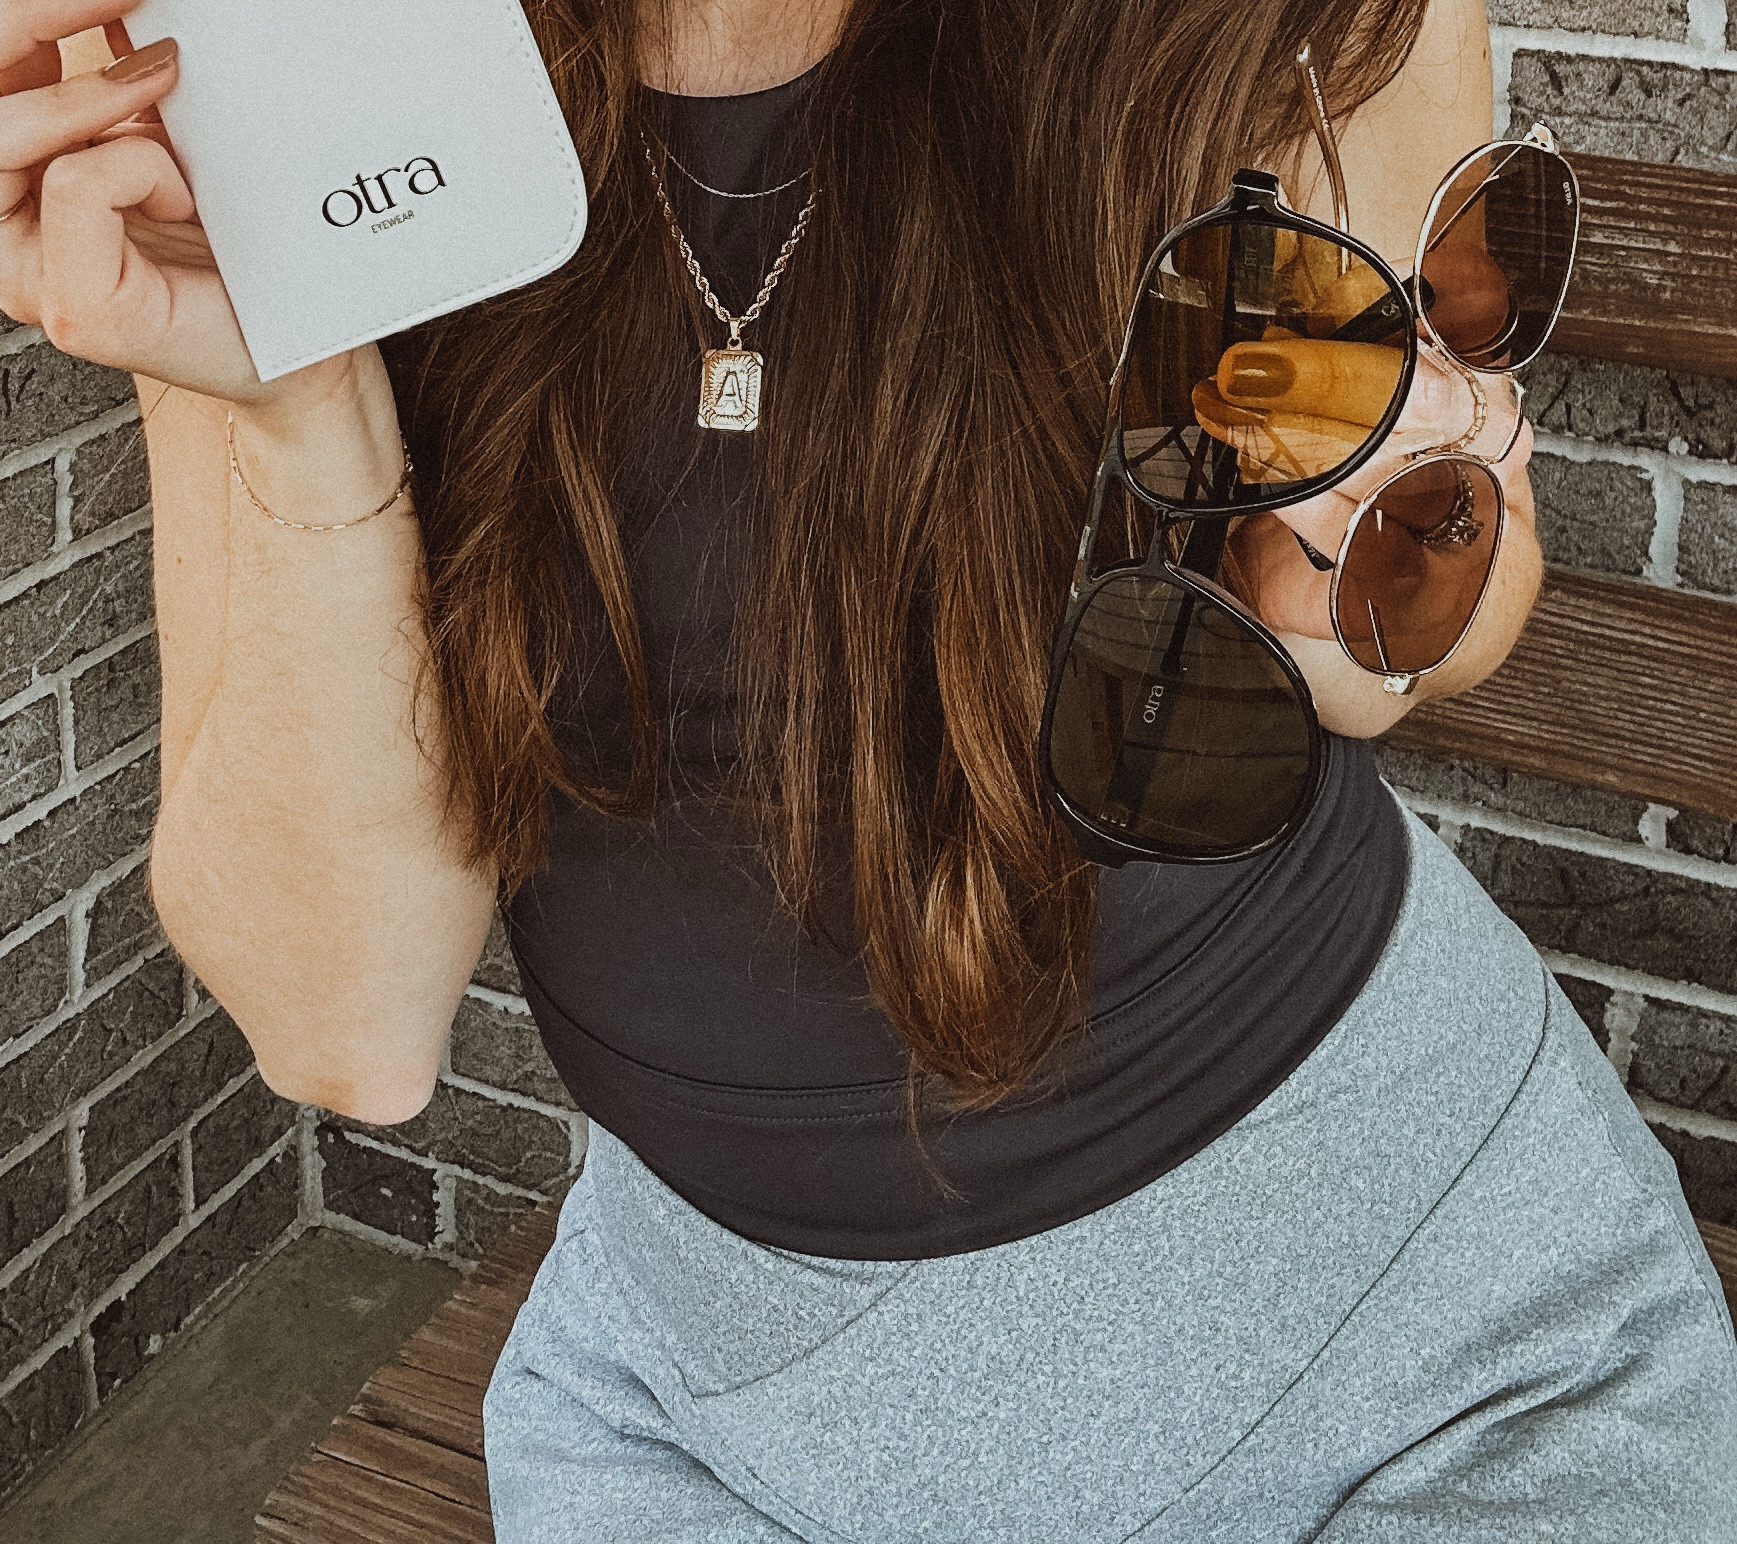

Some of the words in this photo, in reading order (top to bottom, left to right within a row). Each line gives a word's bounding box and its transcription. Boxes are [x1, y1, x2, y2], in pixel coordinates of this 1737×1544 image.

[321, 156, 447, 228] otra
[370, 209, 415, 234] EYEWEAR
[714, 370, 744, 408] A
[1142, 685, 1165, 724] otra
